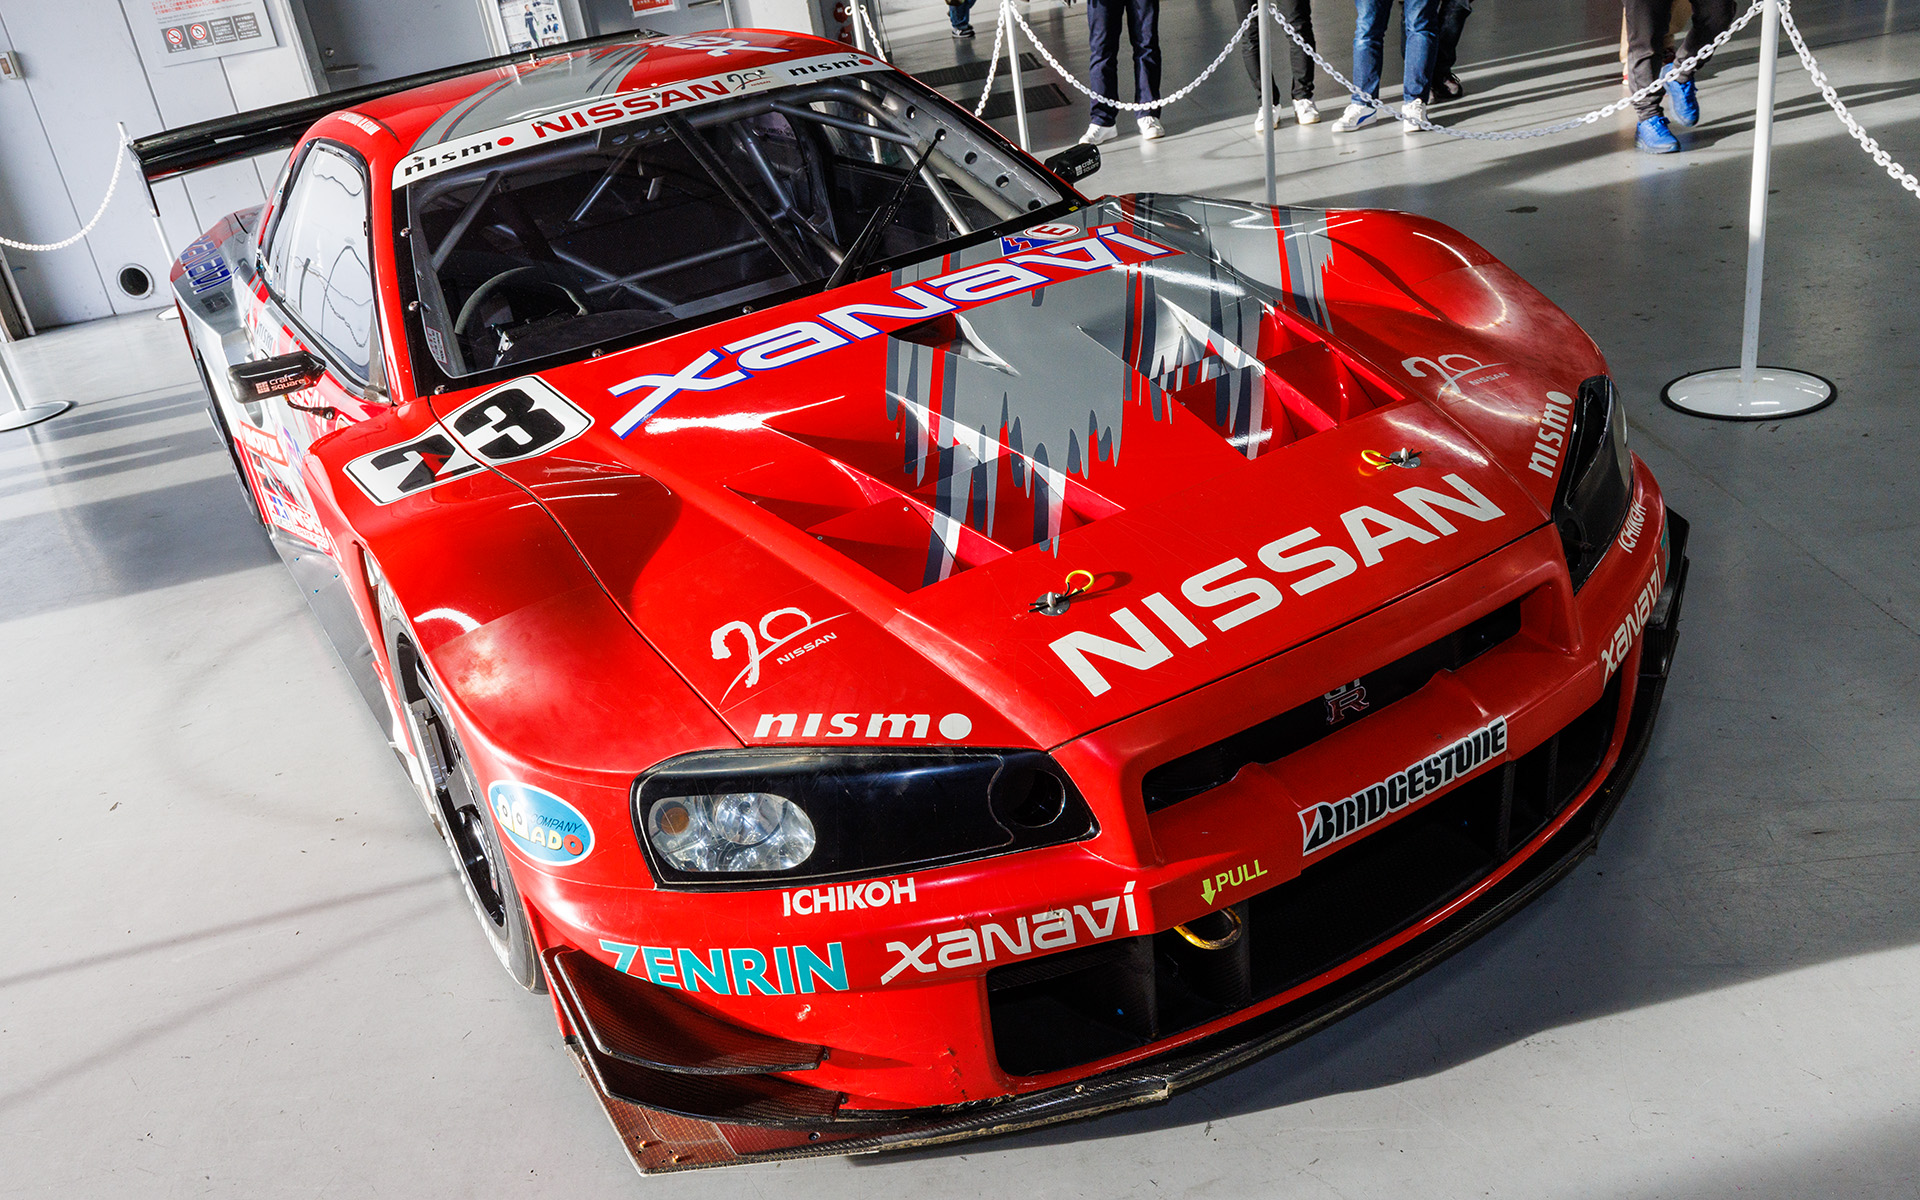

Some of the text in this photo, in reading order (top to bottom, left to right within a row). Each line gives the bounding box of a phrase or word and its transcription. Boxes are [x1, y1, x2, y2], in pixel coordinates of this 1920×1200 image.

[531, 80, 731, 138] NISSAN
[269, 374, 294, 386] craft
[271, 378, 306, 392] square
[1468, 371, 1510, 386] NISSAN
[370, 388, 566, 493] 23
[1618, 497, 1647, 554] ICHIKOH
[1048, 473, 1506, 697] NISSAN
[776, 632, 838, 665] NISSAN
[1300, 717, 1507, 855] BRIDGESTONE
[531, 813, 582, 833] COMPANY
[1215, 859, 1268, 892] PULL
[783, 877, 917, 917] ICHIKOH
[600, 939, 851, 996] ZENRIN
